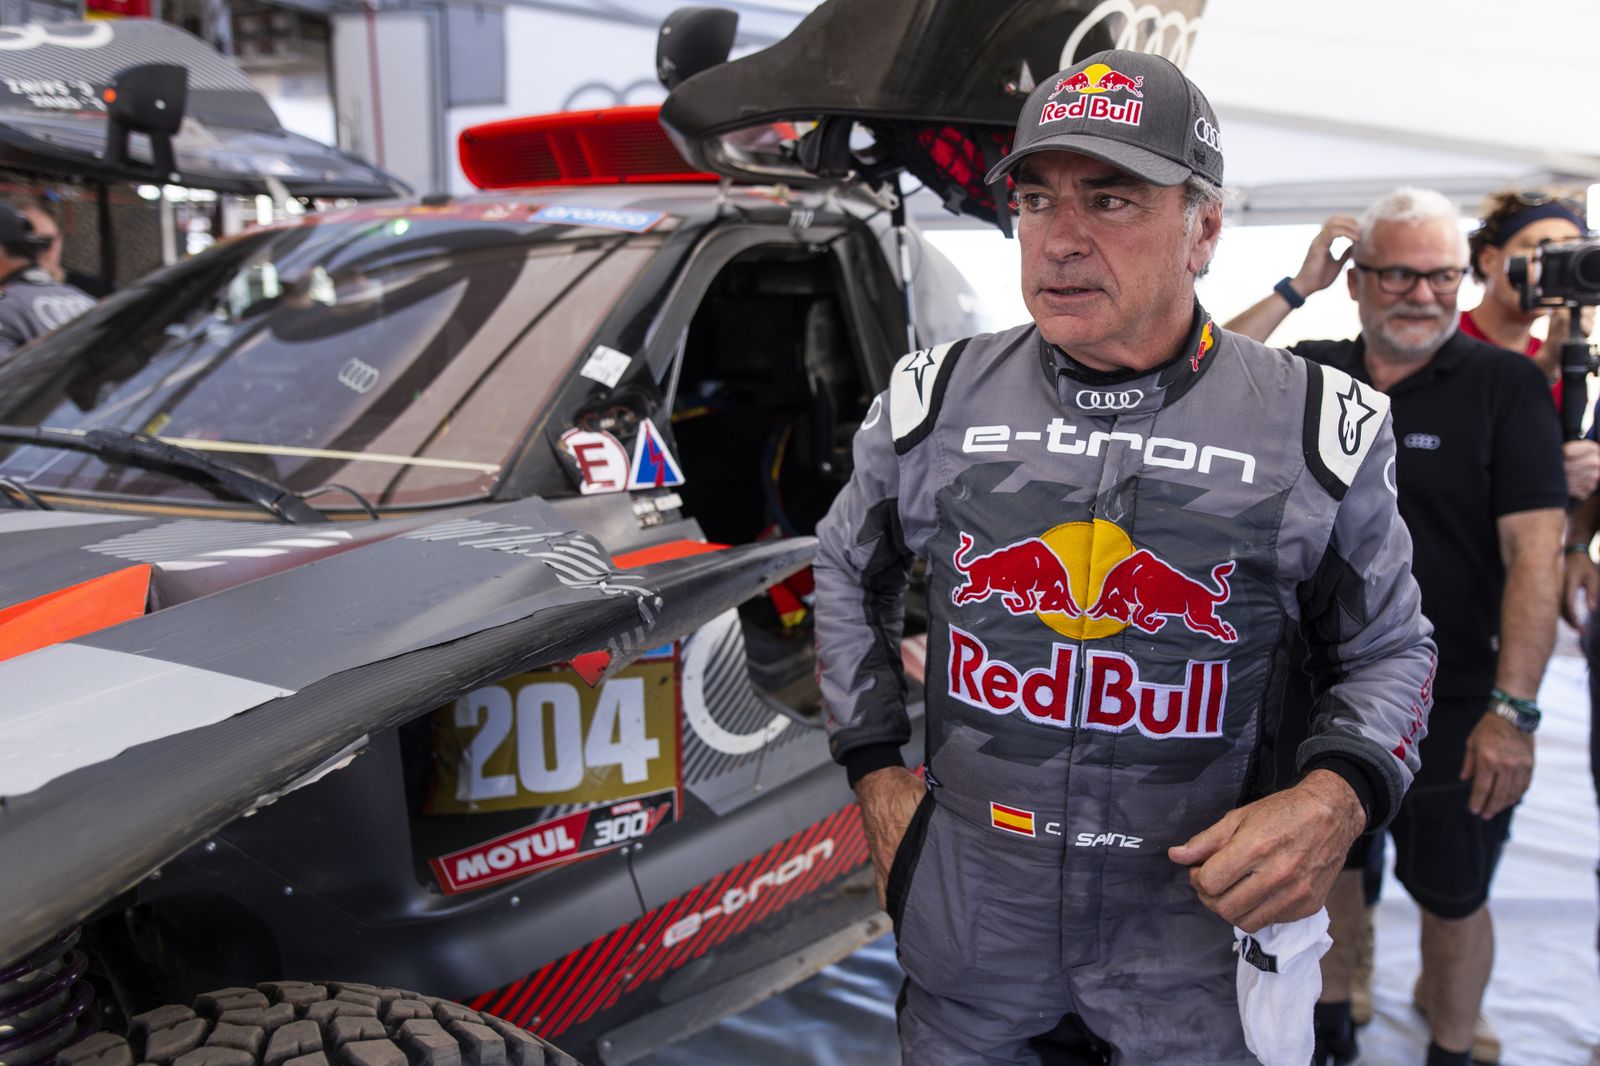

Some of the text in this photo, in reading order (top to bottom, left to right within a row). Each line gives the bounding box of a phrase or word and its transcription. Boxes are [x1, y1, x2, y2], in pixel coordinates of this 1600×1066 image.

[1040, 95, 1142, 126] Red Bull
[573, 442, 616, 488] E
[962, 417, 1256, 484] e-tron
[949, 625, 1229, 738] Red Bull
[454, 676, 661, 802] 204
[456, 802, 671, 882] MOTUL 300V
[1045, 822, 1144, 849] C. SAINZ
[663, 838, 834, 948] e-tron
